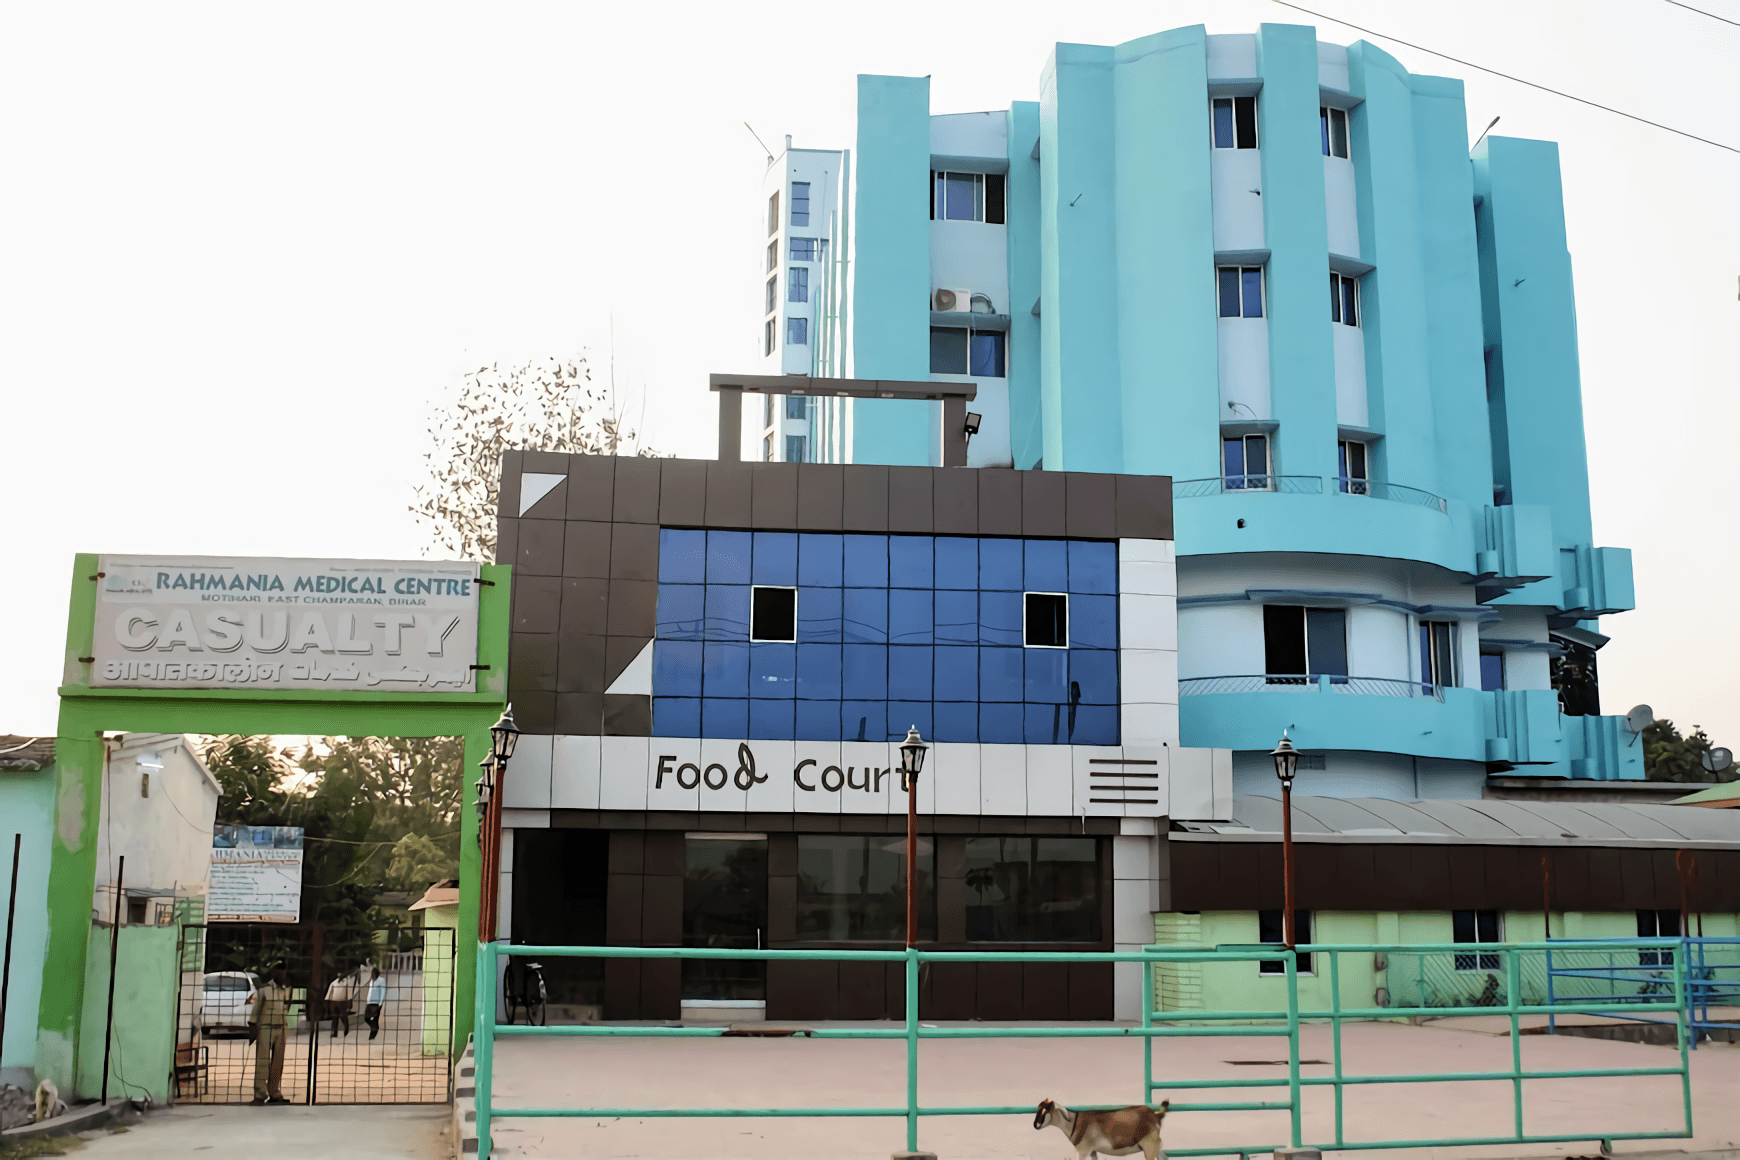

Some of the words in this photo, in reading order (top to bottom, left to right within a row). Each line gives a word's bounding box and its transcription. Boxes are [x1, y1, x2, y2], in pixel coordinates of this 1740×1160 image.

[156, 571, 285, 592] RAHMANIA
[293, 575, 387, 595] MEDICAL
[394, 577, 471, 597] CENTRE
[115, 608, 461, 657] CASUALTY
[655, 742, 768, 792] Food
[794, 758, 911, 794] Court
